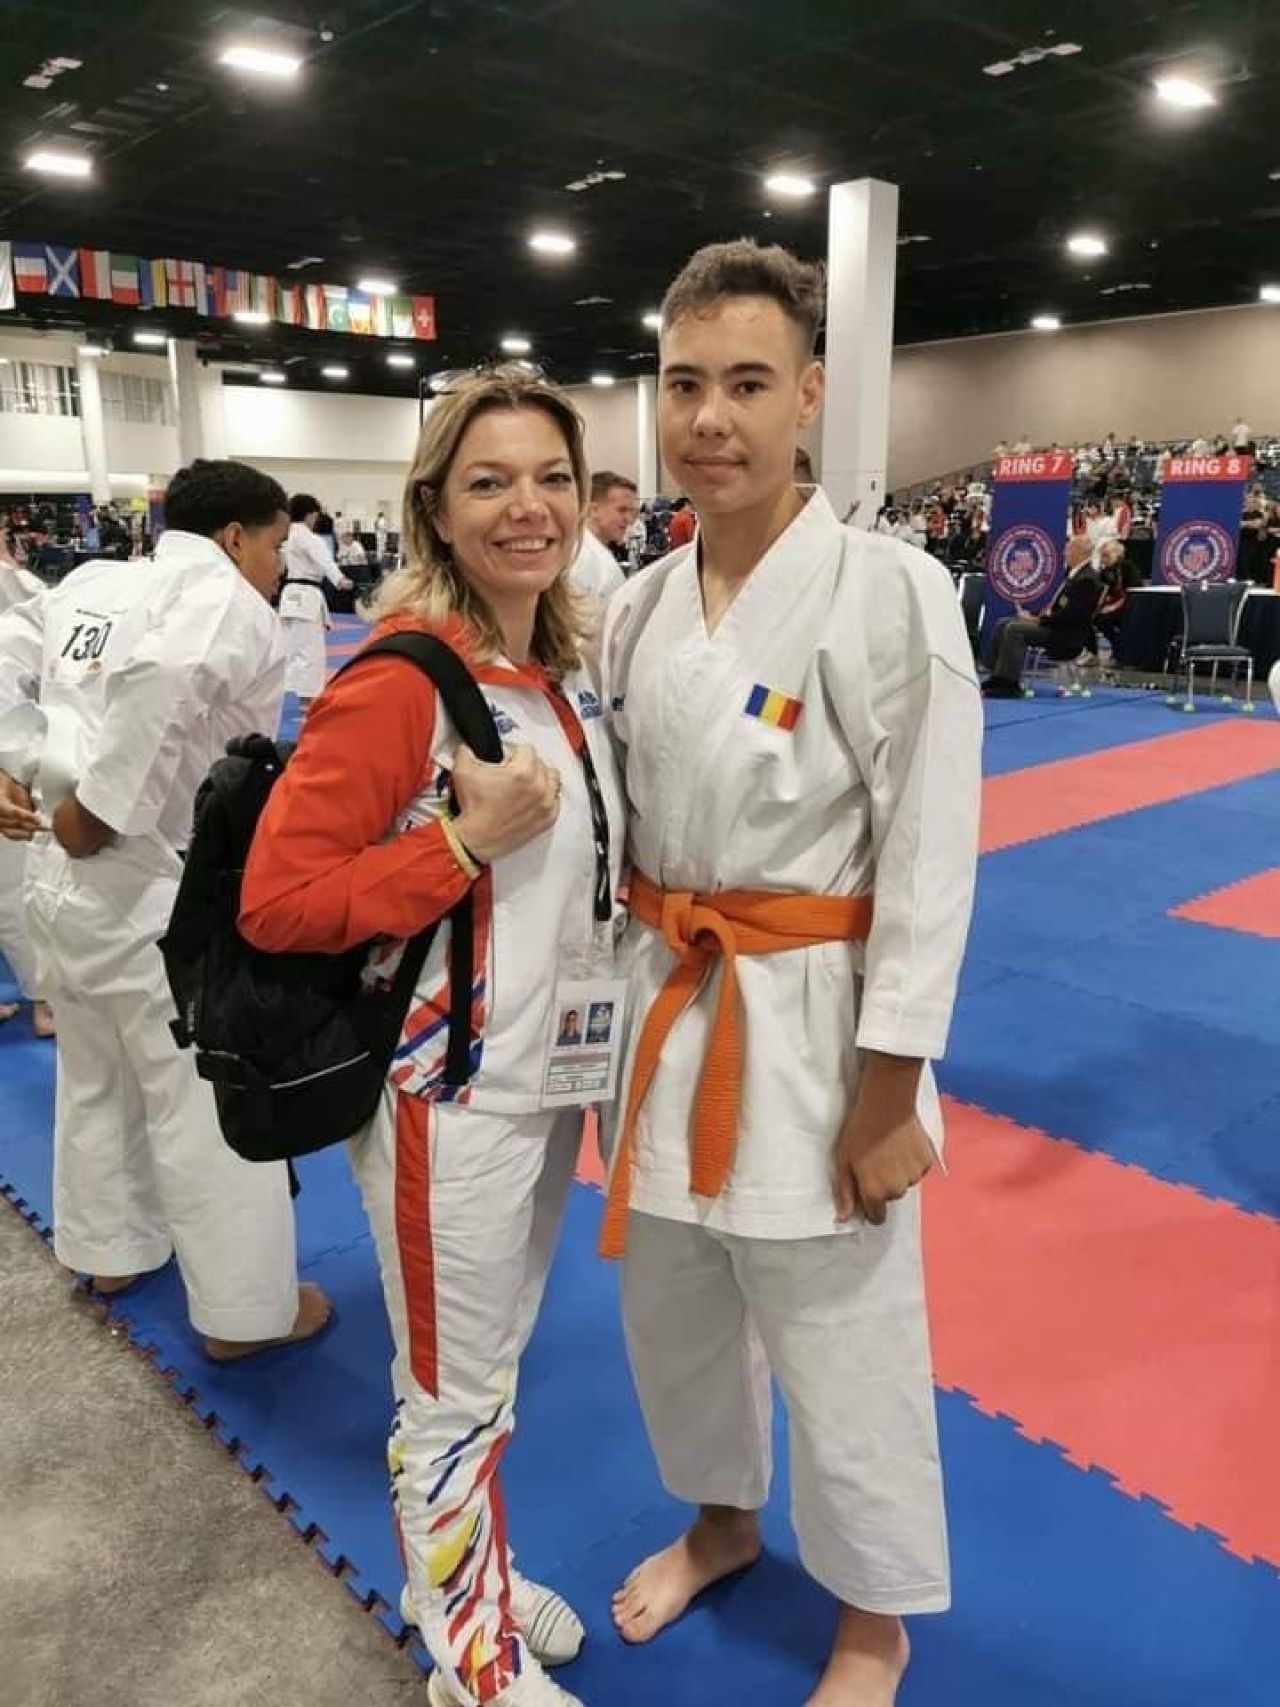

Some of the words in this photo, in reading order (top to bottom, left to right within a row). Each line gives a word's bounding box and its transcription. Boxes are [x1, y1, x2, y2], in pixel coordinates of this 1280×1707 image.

[1000, 457, 1045, 476] RING
[1051, 456, 1064, 474] 7
[1170, 458, 1220, 476] RING
[1227, 458, 1241, 474] 8
[61, 621, 112, 661] 130
